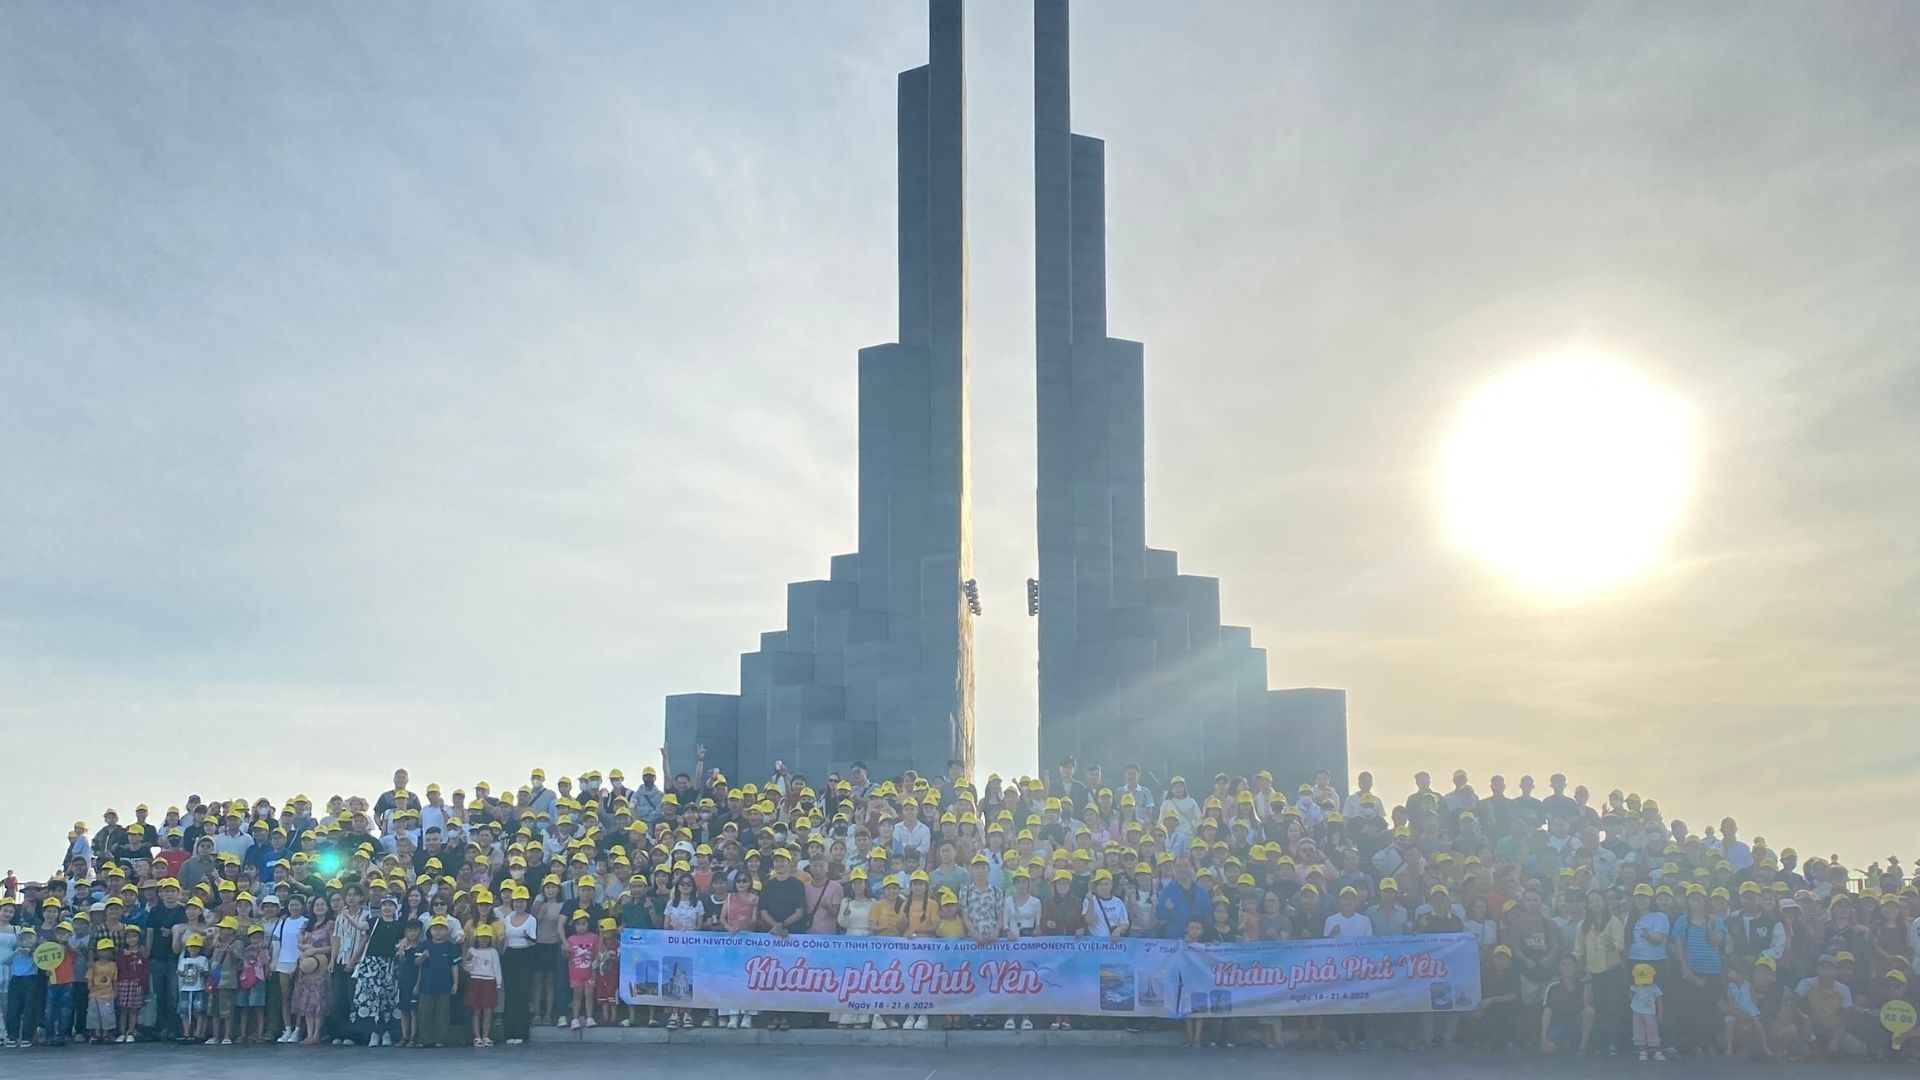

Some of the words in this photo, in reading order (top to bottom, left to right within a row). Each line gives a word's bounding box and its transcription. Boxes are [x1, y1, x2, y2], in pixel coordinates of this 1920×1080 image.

[668, 936, 680, 944] DU
[682, 936, 701, 947] LỊCH
[703, 937, 743, 946] NEWTOUR
[832, 940, 842, 949] TY
[844, 940, 869, 950] TNHH
[871, 940, 910, 950] TOYOTSU
[911, 941, 942, 951] SAFETY
[944, 942, 951, 951] &
[953, 943, 1011, 951] AUTOMOTIVE
[1012, 942, 1075, 951] COMPONENTS
[38, 954, 48, 963] XE
[51, 951, 62, 960] 12
[745, 956, 839, 993] Khám
[838, 959, 904, 1003] phá
[908, 959, 975, 995] Phú
[978, 959, 1043, 994] Yên
[1212, 960, 1287, 987] Khám
[1288, 957, 1340, 990] phá
[1343, 953, 1396, 981] Phú
[1397, 952, 1448, 979] Yên
